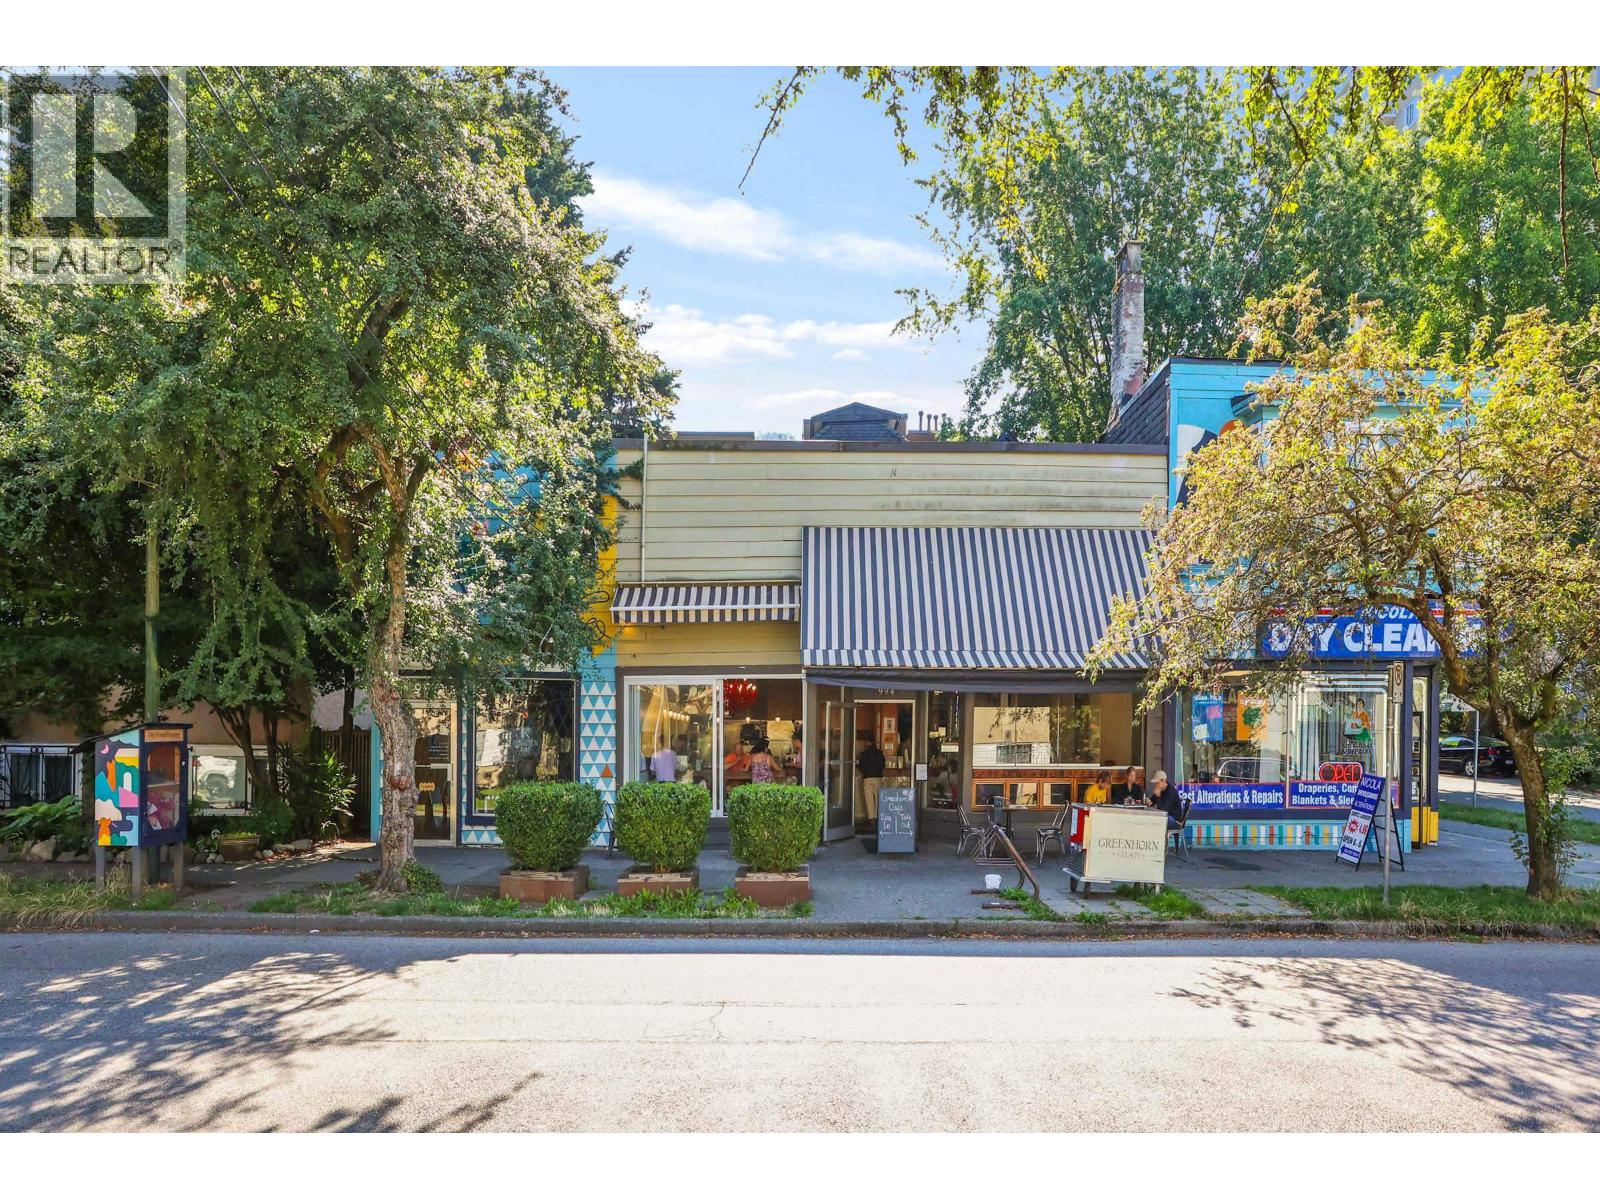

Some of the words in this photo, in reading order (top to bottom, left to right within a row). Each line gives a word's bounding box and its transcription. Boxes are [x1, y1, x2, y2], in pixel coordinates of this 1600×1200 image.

[1343, 622, 1441, 652] CLEAN
[1298, 783, 1339, 794] Draperies,
[1341, 783, 1357, 793] Com
[1361, 776, 1382, 790] NICOLA
[1196, 790, 1241, 804] Alterations
[1243, 790, 1250, 804] &
[1251, 790, 1284, 805] Repairs
[1292, 795, 1329, 805] Blankets
[1330, 795, 1337, 805] &
[1338, 795, 1355, 805] Slee
[1098, 838, 1160, 850] GREENHORN
